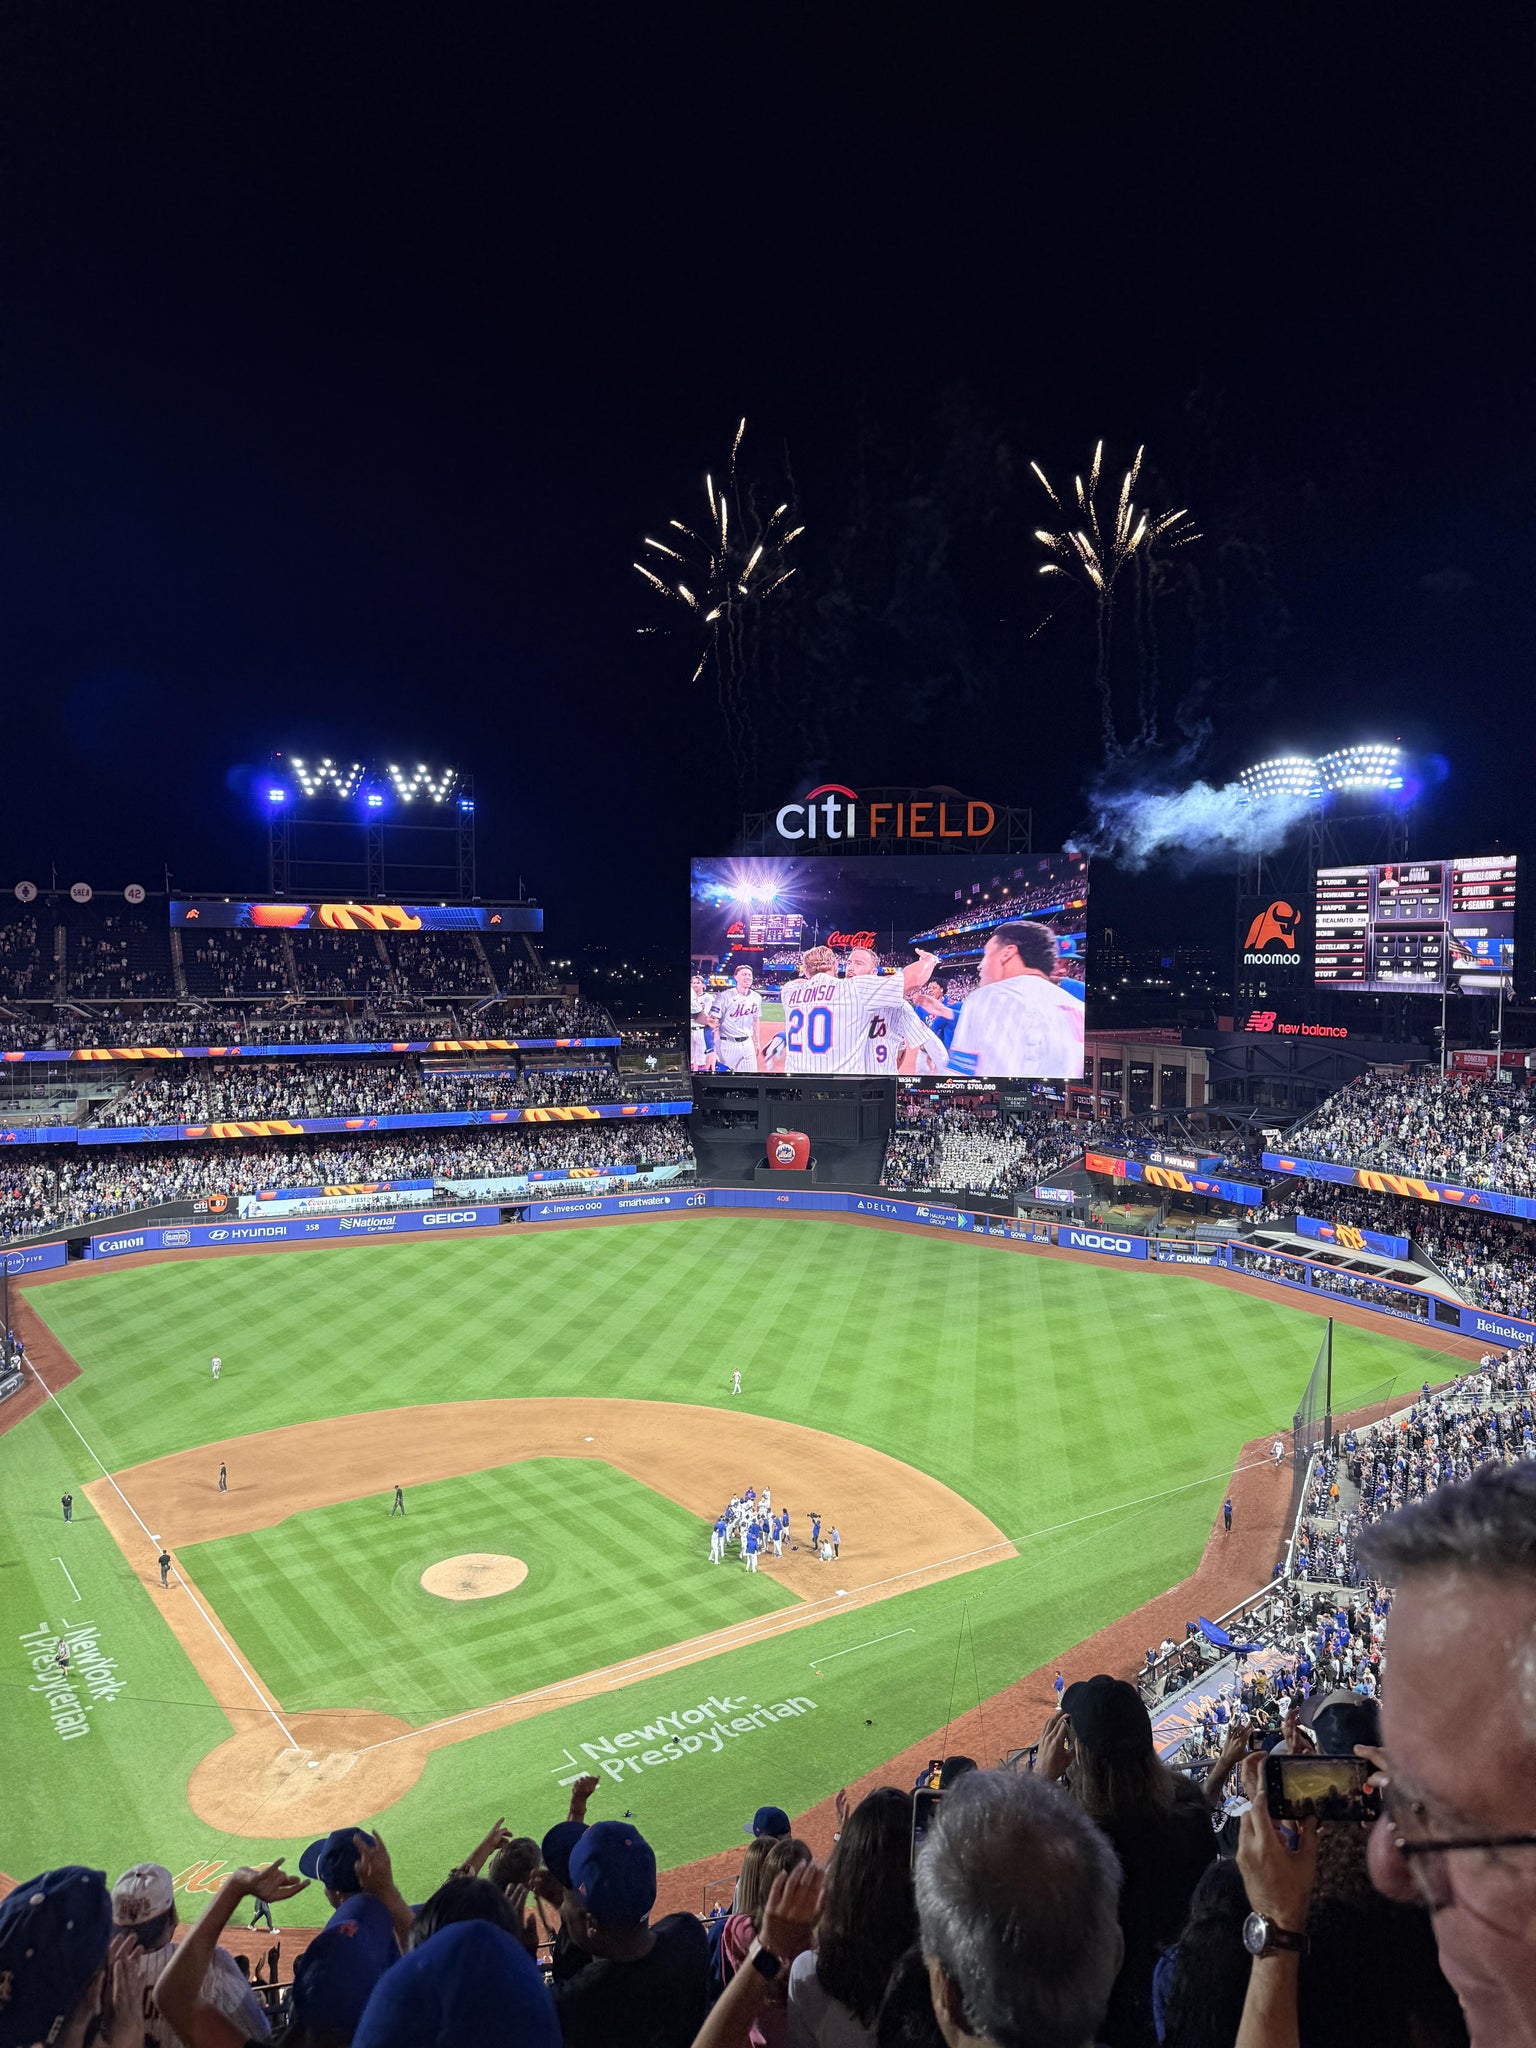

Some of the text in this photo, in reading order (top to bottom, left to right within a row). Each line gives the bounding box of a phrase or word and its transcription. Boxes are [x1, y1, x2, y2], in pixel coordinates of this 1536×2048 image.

[776, 794, 995, 839] citi FIELD
[128, 889, 142, 899] 42
[1462, 885, 1490, 896] SPLITTER
[1461, 900, 1487, 910] 4-SEAM
[1243, 953, 1300, 965] moomoo
[788, 984, 836, 1005] ALONSO
[788, 1006, 834, 1055] 20
[1277, 1023, 1348, 1038] new balance
[875, 1044, 888, 1063] 9
[966, 1083, 996, 1091] $700,000
[1150, 1153, 1196, 1169] citi PAVILION
[193, 1200, 208, 1209] citi
[618, 1196, 664, 1208] smartwater
[686, 1195, 706, 1206] citi
[553, 1202, 602, 1213] Invesco QQQ
[867, 1202, 898, 1214] DELTA
[422, 1211, 477, 1225] GEICO
[930, 1213, 957, 1222] HAUGLAND
[231, 1226, 287, 1238] HYUNDAI
[304, 1223, 320, 1231] 358
[972, 1225, 984, 1233] 380
[989, 1227, 1005, 1235] GOYA
[1010, 1231, 1026, 1239] GOYA
[1032, 1234, 1049, 1243] GOYA
[99, 1236, 144, 1252] Canon
[1070, 1231, 1131, 1253] NOCO
[1176, 1255, 1211, 1265] DUNKIN'
[1218, 1258, 1228, 1267] 370
[1245, 1268, 1281, 1283] CADILLAC
[1384, 1308, 1430, 1324] CADILLAC
[1477, 1318, 1533, 1343] Heineken
[1218, 1682, 1236, 1695] citi
[600, 1696, 819, 1782] Presbyterian
